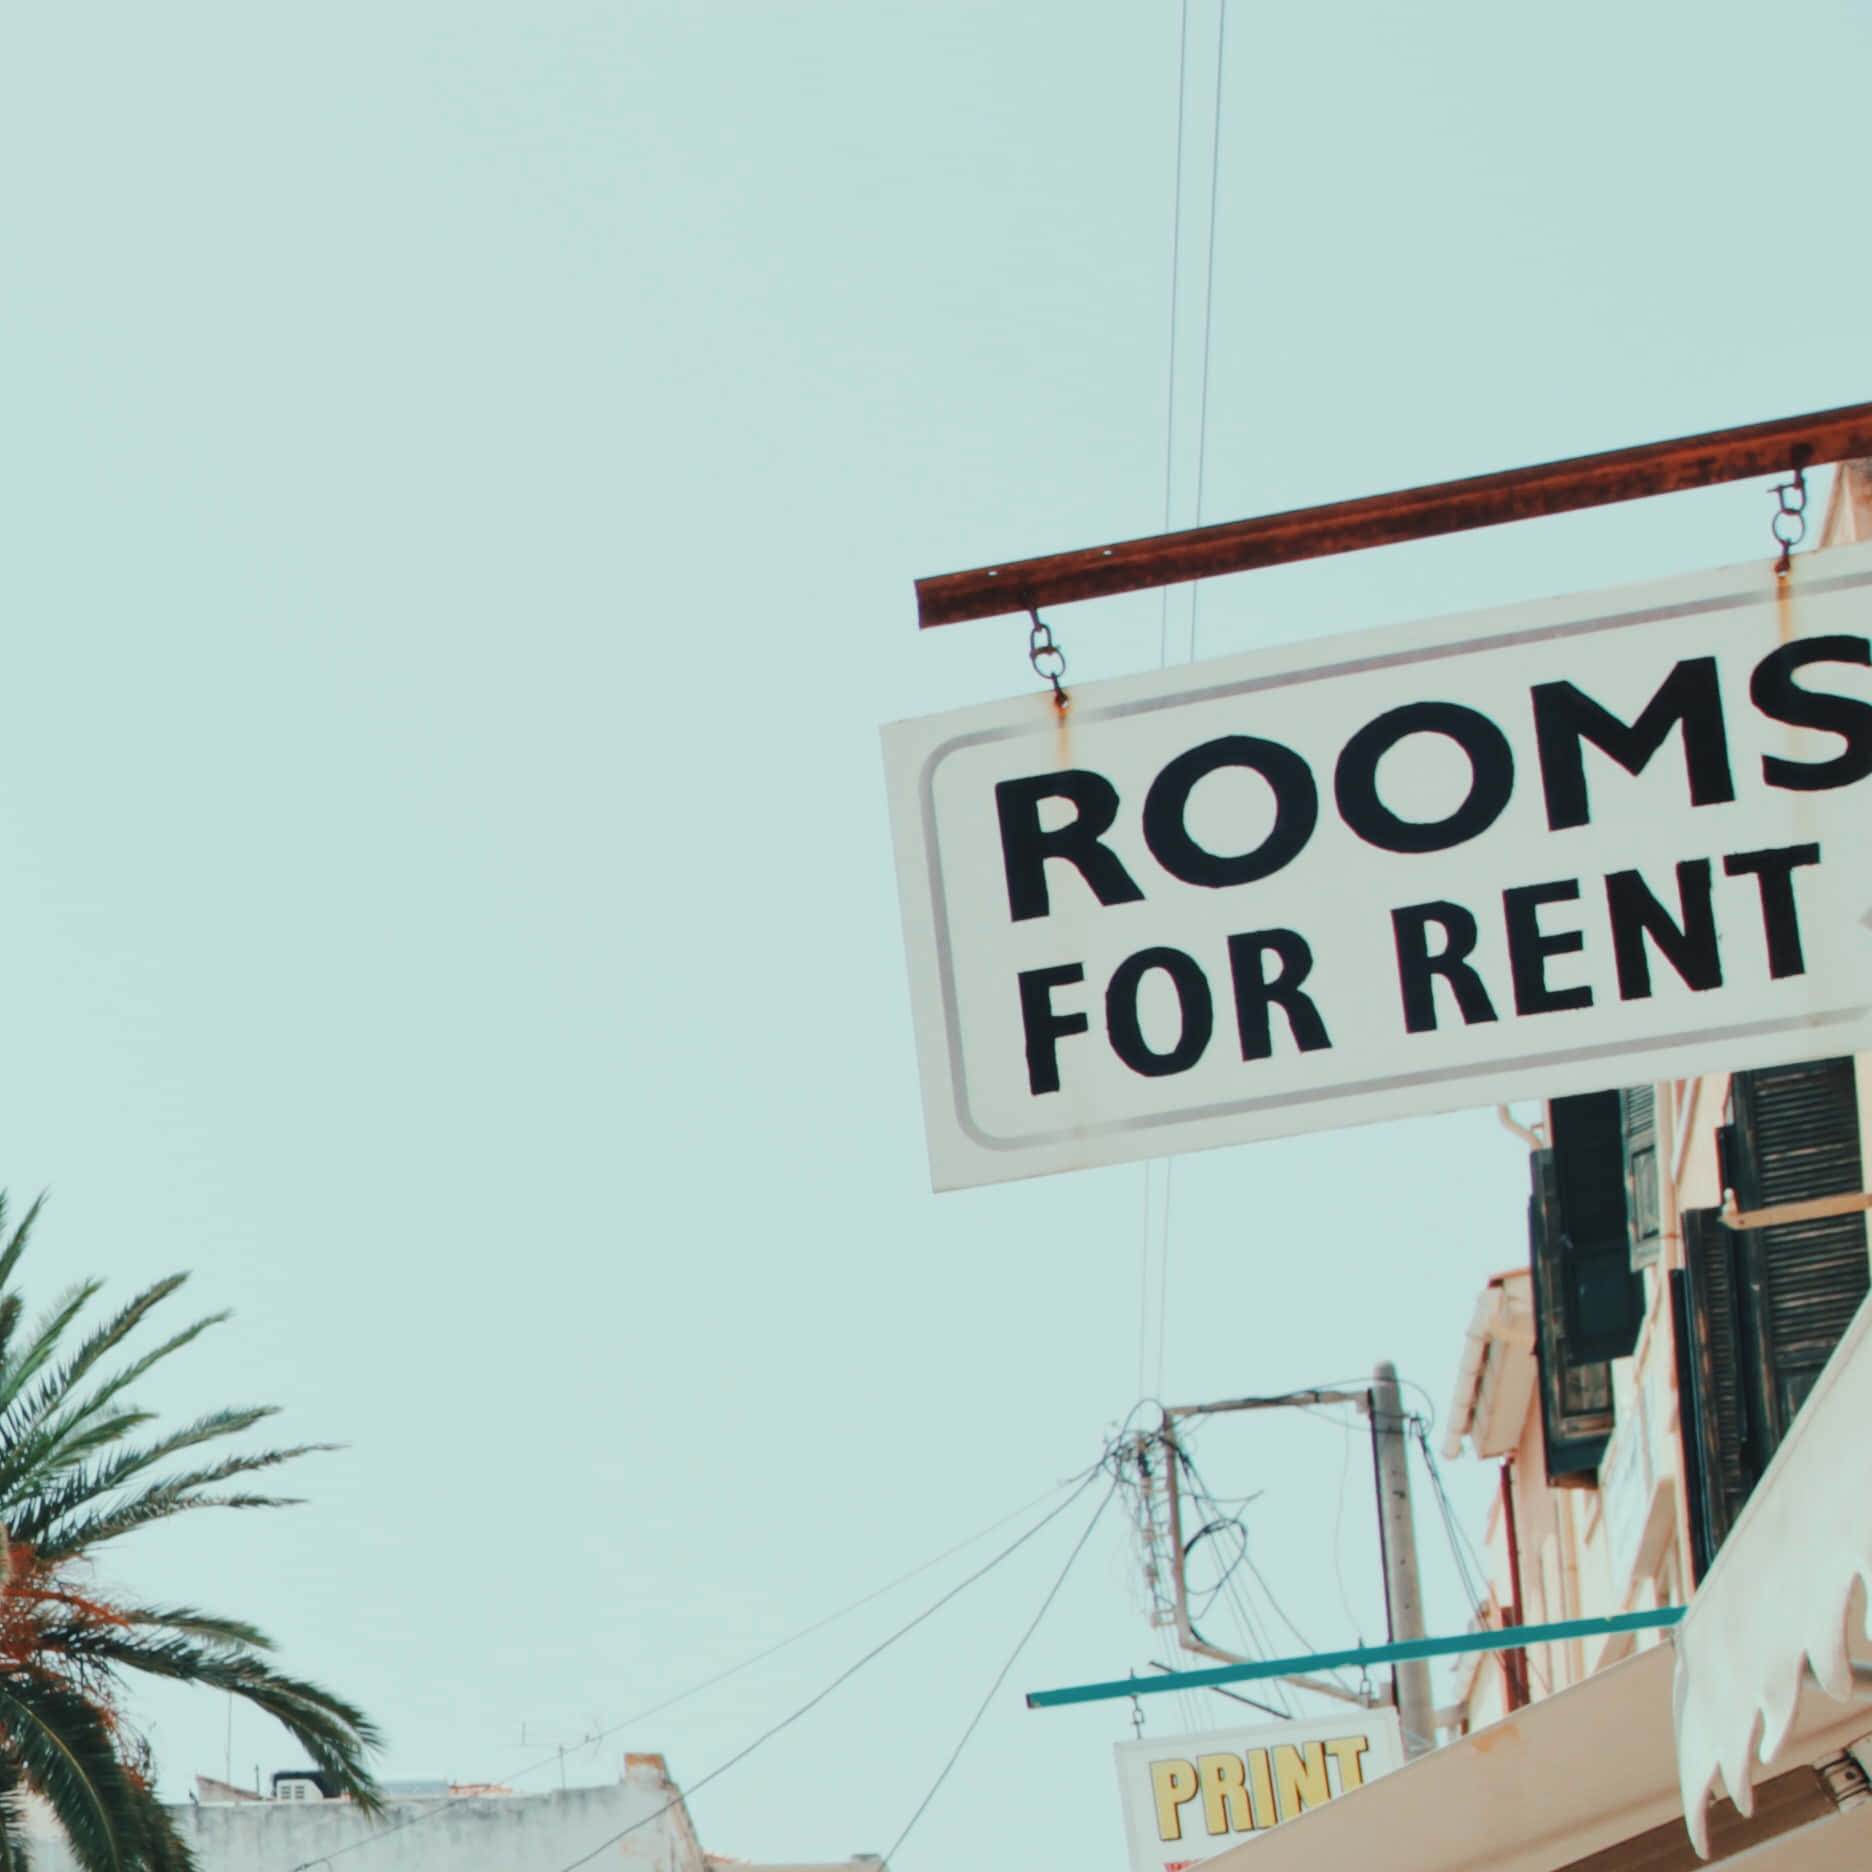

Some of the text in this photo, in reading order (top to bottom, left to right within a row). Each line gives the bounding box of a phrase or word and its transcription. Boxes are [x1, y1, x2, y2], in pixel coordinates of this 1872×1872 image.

[995, 633, 1872, 922] ROOMS
[1017, 842, 1820, 1096] FOR RENT
[1149, 1735, 1369, 1841] PRINT
